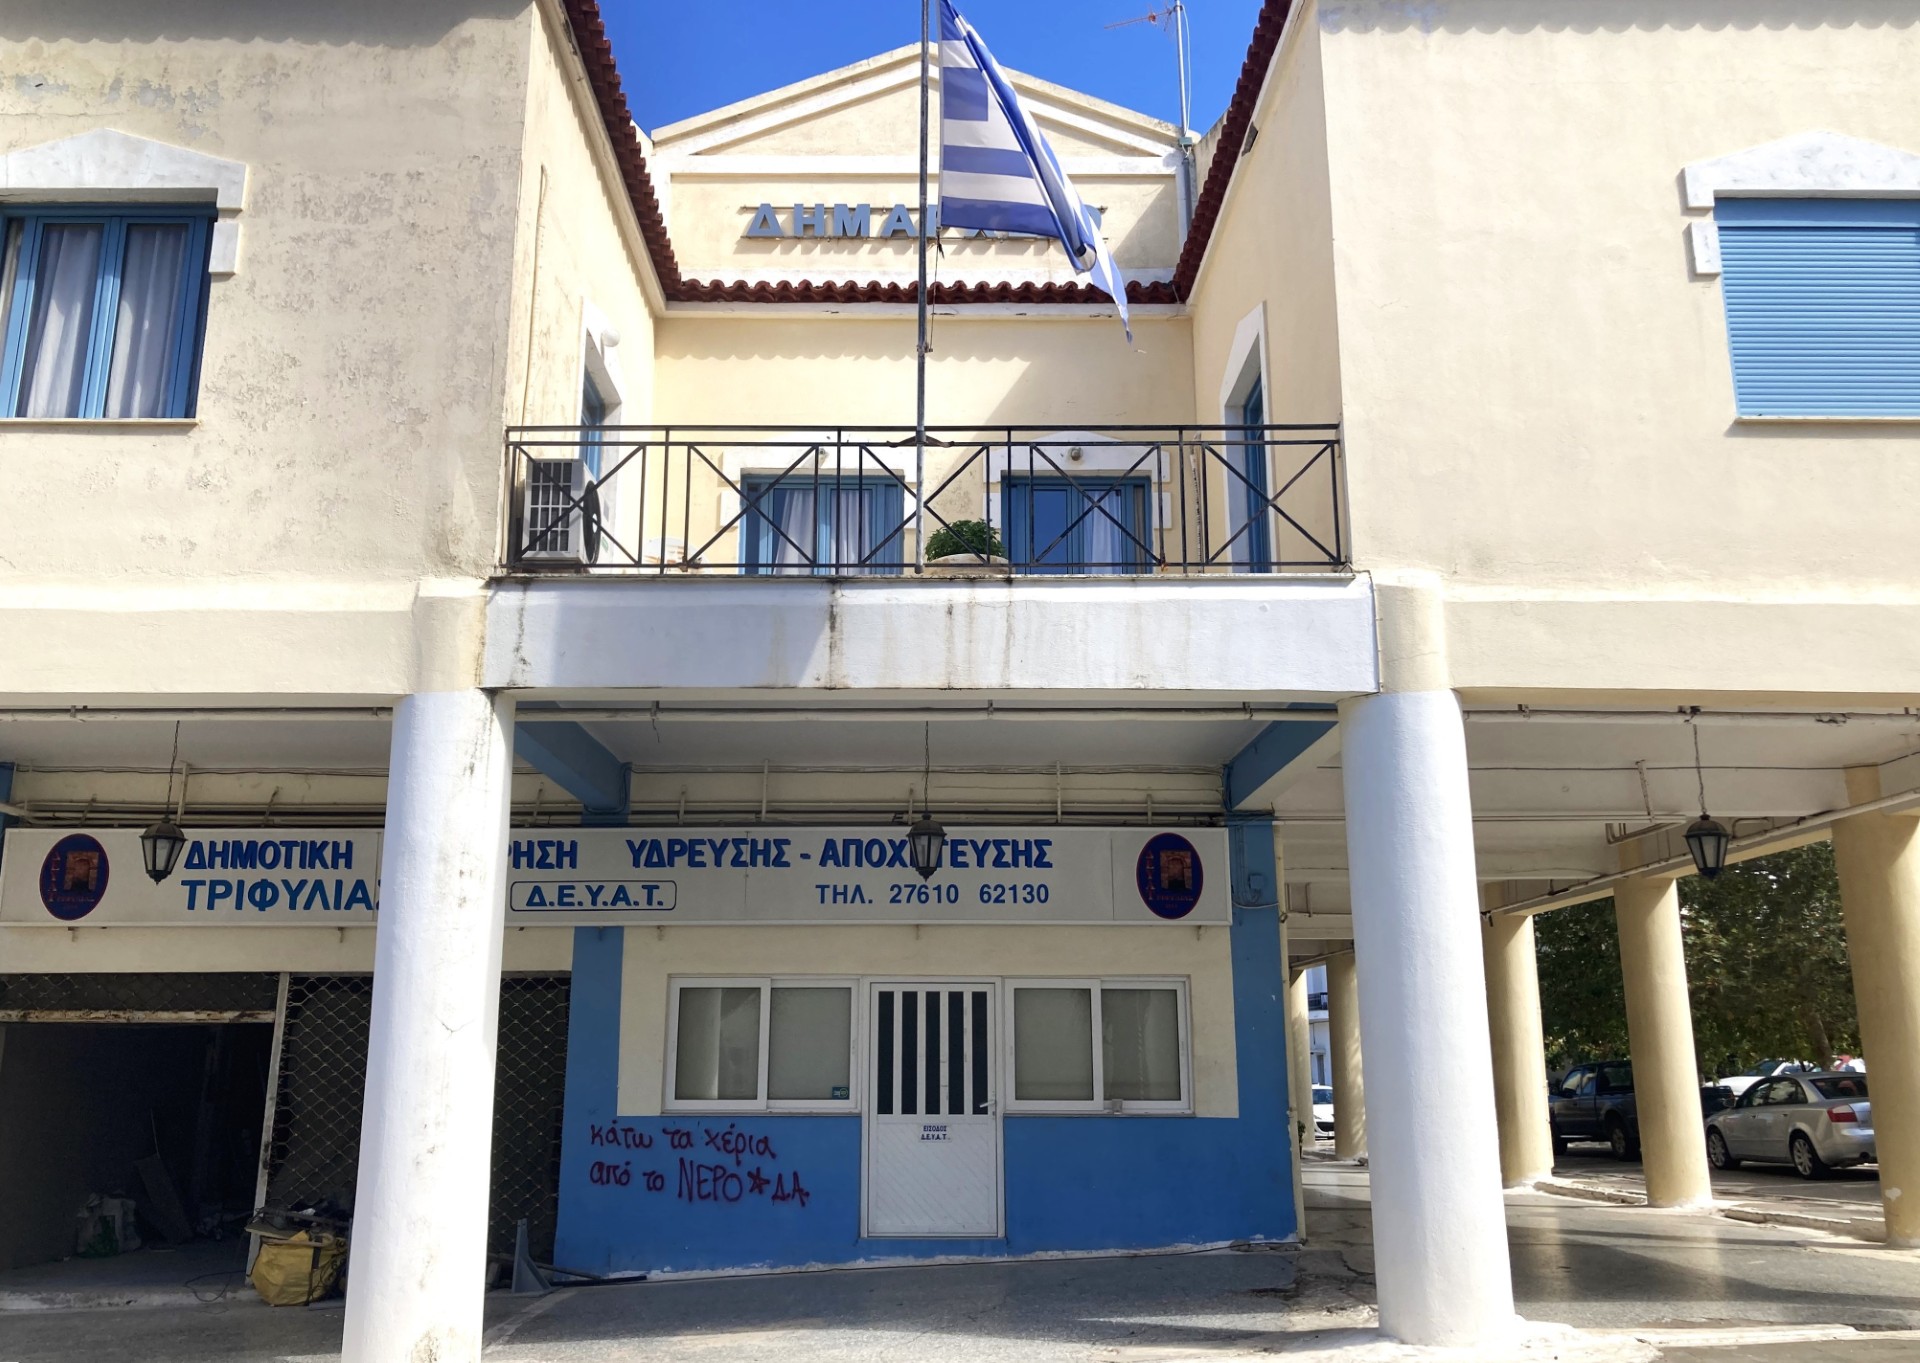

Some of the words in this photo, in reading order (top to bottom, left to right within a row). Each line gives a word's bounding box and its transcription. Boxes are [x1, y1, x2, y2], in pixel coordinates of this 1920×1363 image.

[184, 840, 353, 870] ΔΗΜΟΤΙΚΗ
[625, 838, 790, 868] ΥΔΡΕΥΣΗΣ
[819, 838, 1053, 868] ΑΠΟΧΕΥΣΗΣ
[181, 879, 382, 911] ΤΡΙΦΥΛΙΑ
[526, 884, 664, 907] Δ.Ε.Υ.Α.Τ.
[815, 884, 873, 904] ΤΗΛ.
[889, 883, 959, 904] 27610
[979, 883, 1049, 904] 62130
[591, 1120, 653, 1149] κάτω
[662, 1127, 694, 1150] τα
[704, 1123, 777, 1167] χέρια
[590, 1161, 631, 1186] από
[642, 1170, 665, 1191] το
